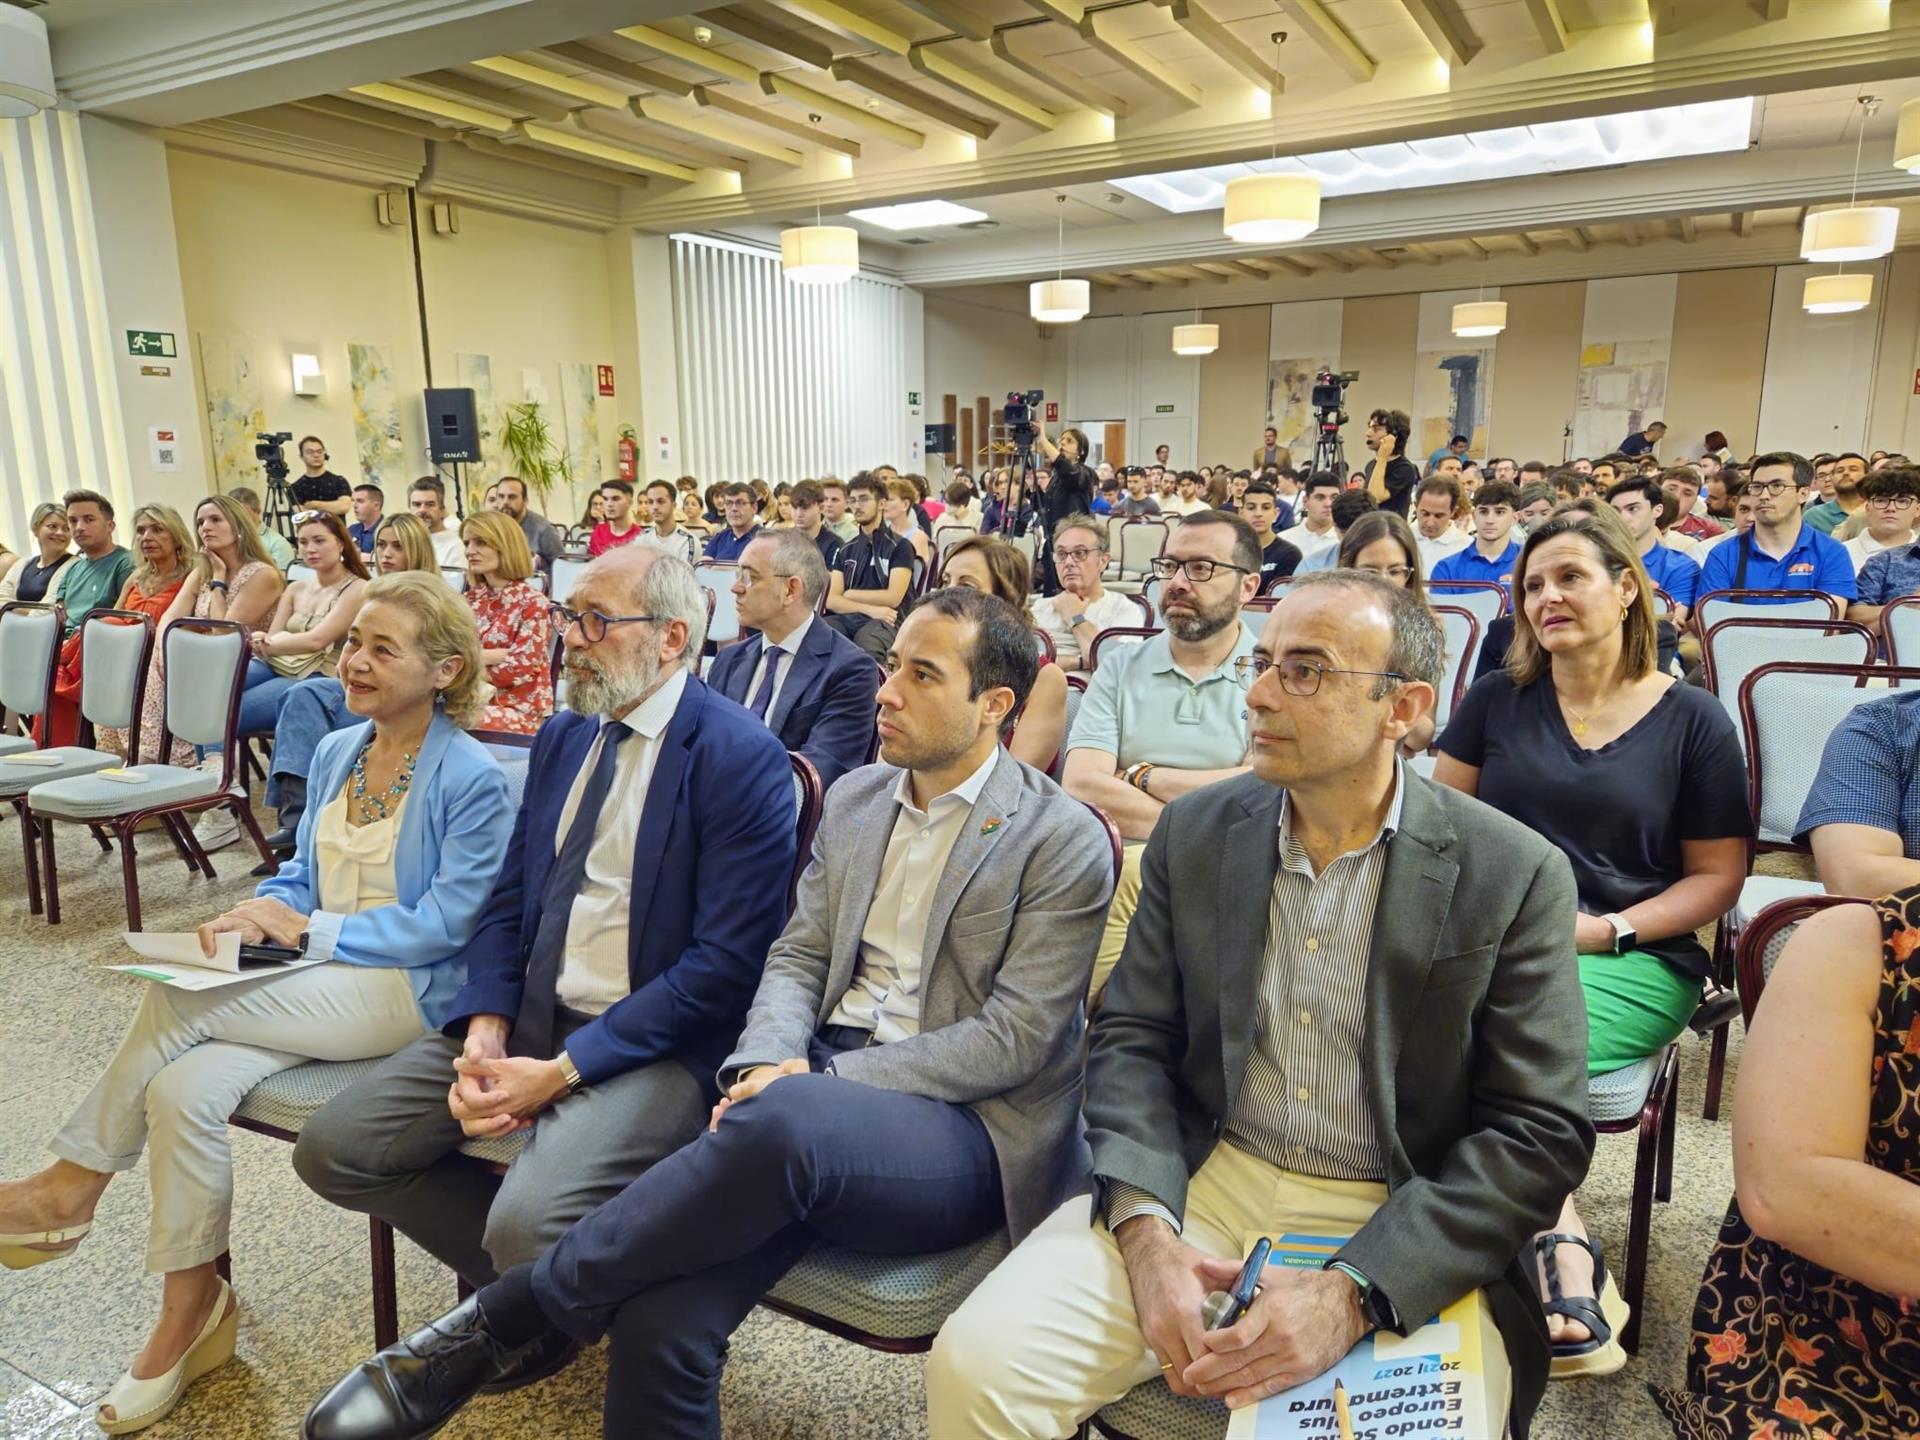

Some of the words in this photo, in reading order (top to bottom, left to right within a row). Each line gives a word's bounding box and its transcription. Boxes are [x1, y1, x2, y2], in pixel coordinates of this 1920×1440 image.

[1373, 1365, 1413, 1380] 2027
[1358, 1398, 1462, 1422] Europeo
[1385, 1416, 1463, 1437] Fondo
